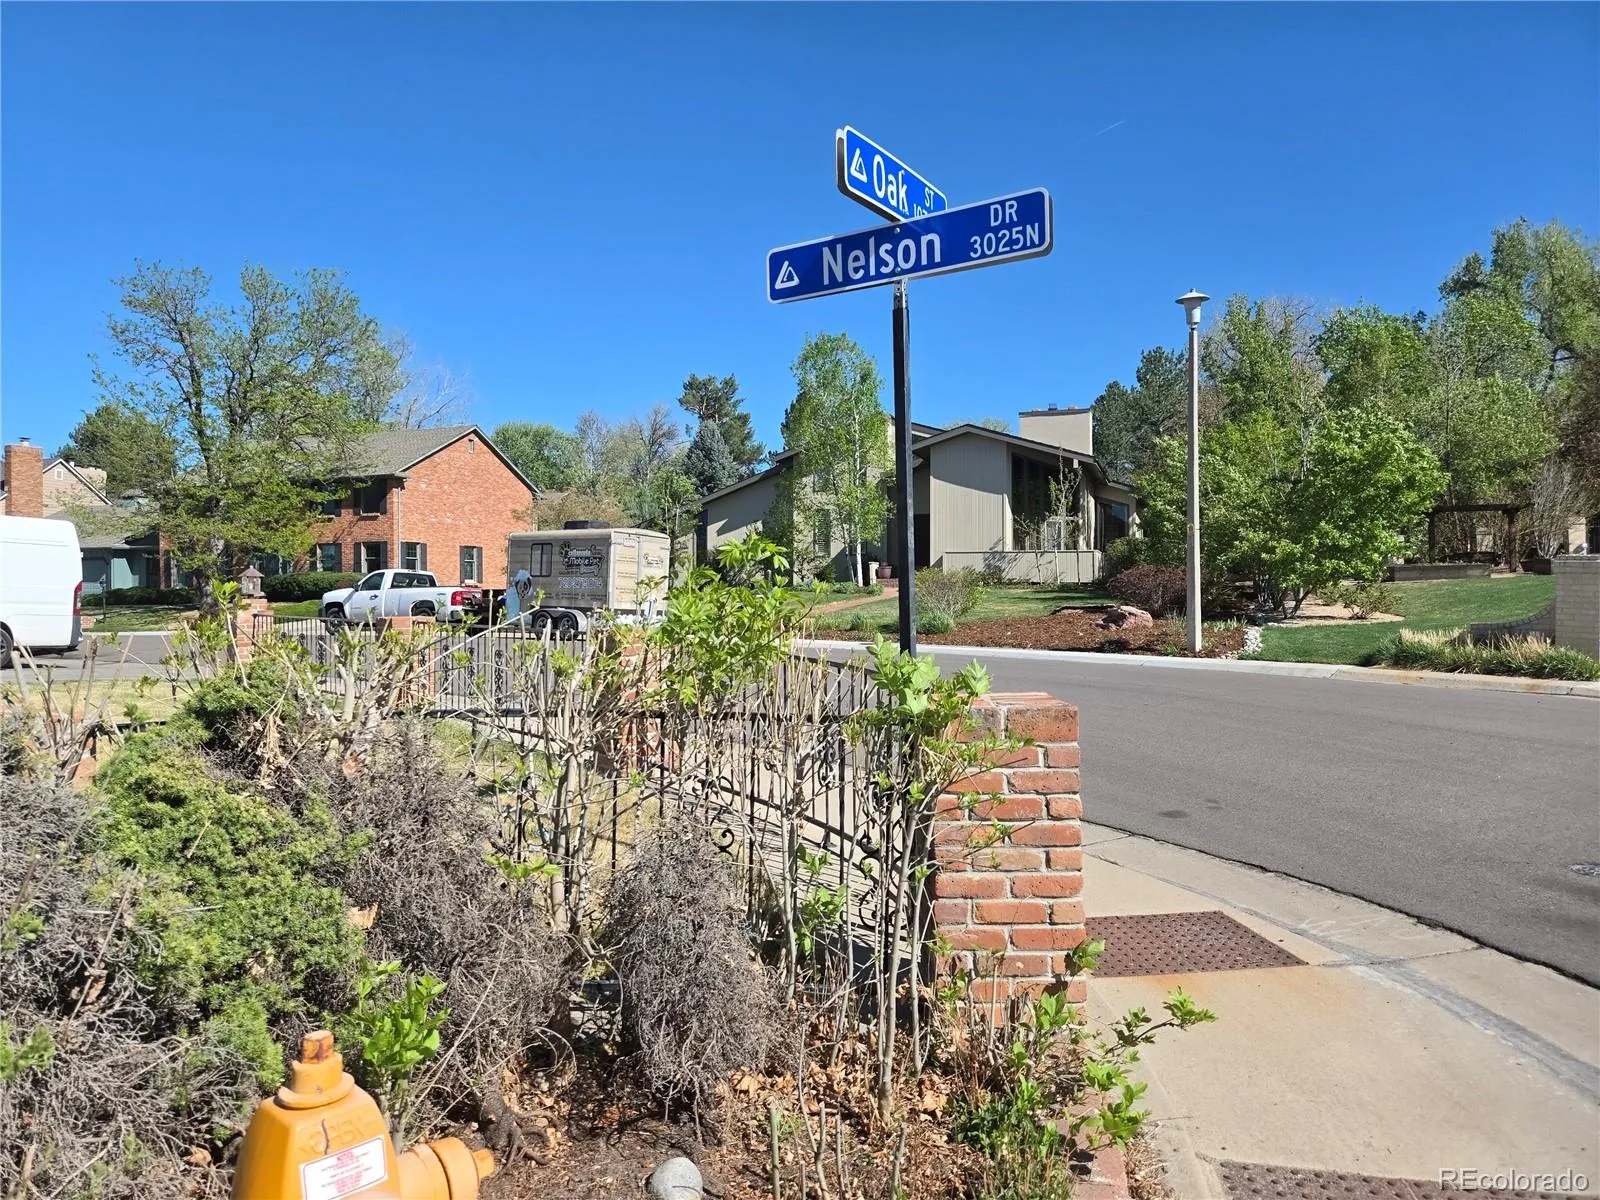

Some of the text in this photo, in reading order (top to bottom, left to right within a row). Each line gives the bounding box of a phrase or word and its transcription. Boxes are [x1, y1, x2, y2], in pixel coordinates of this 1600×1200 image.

[873, 154, 934, 215] Oak ST
[822, 200, 1017, 285] Nelson DR
[970, 222, 1039, 258] 3025N
